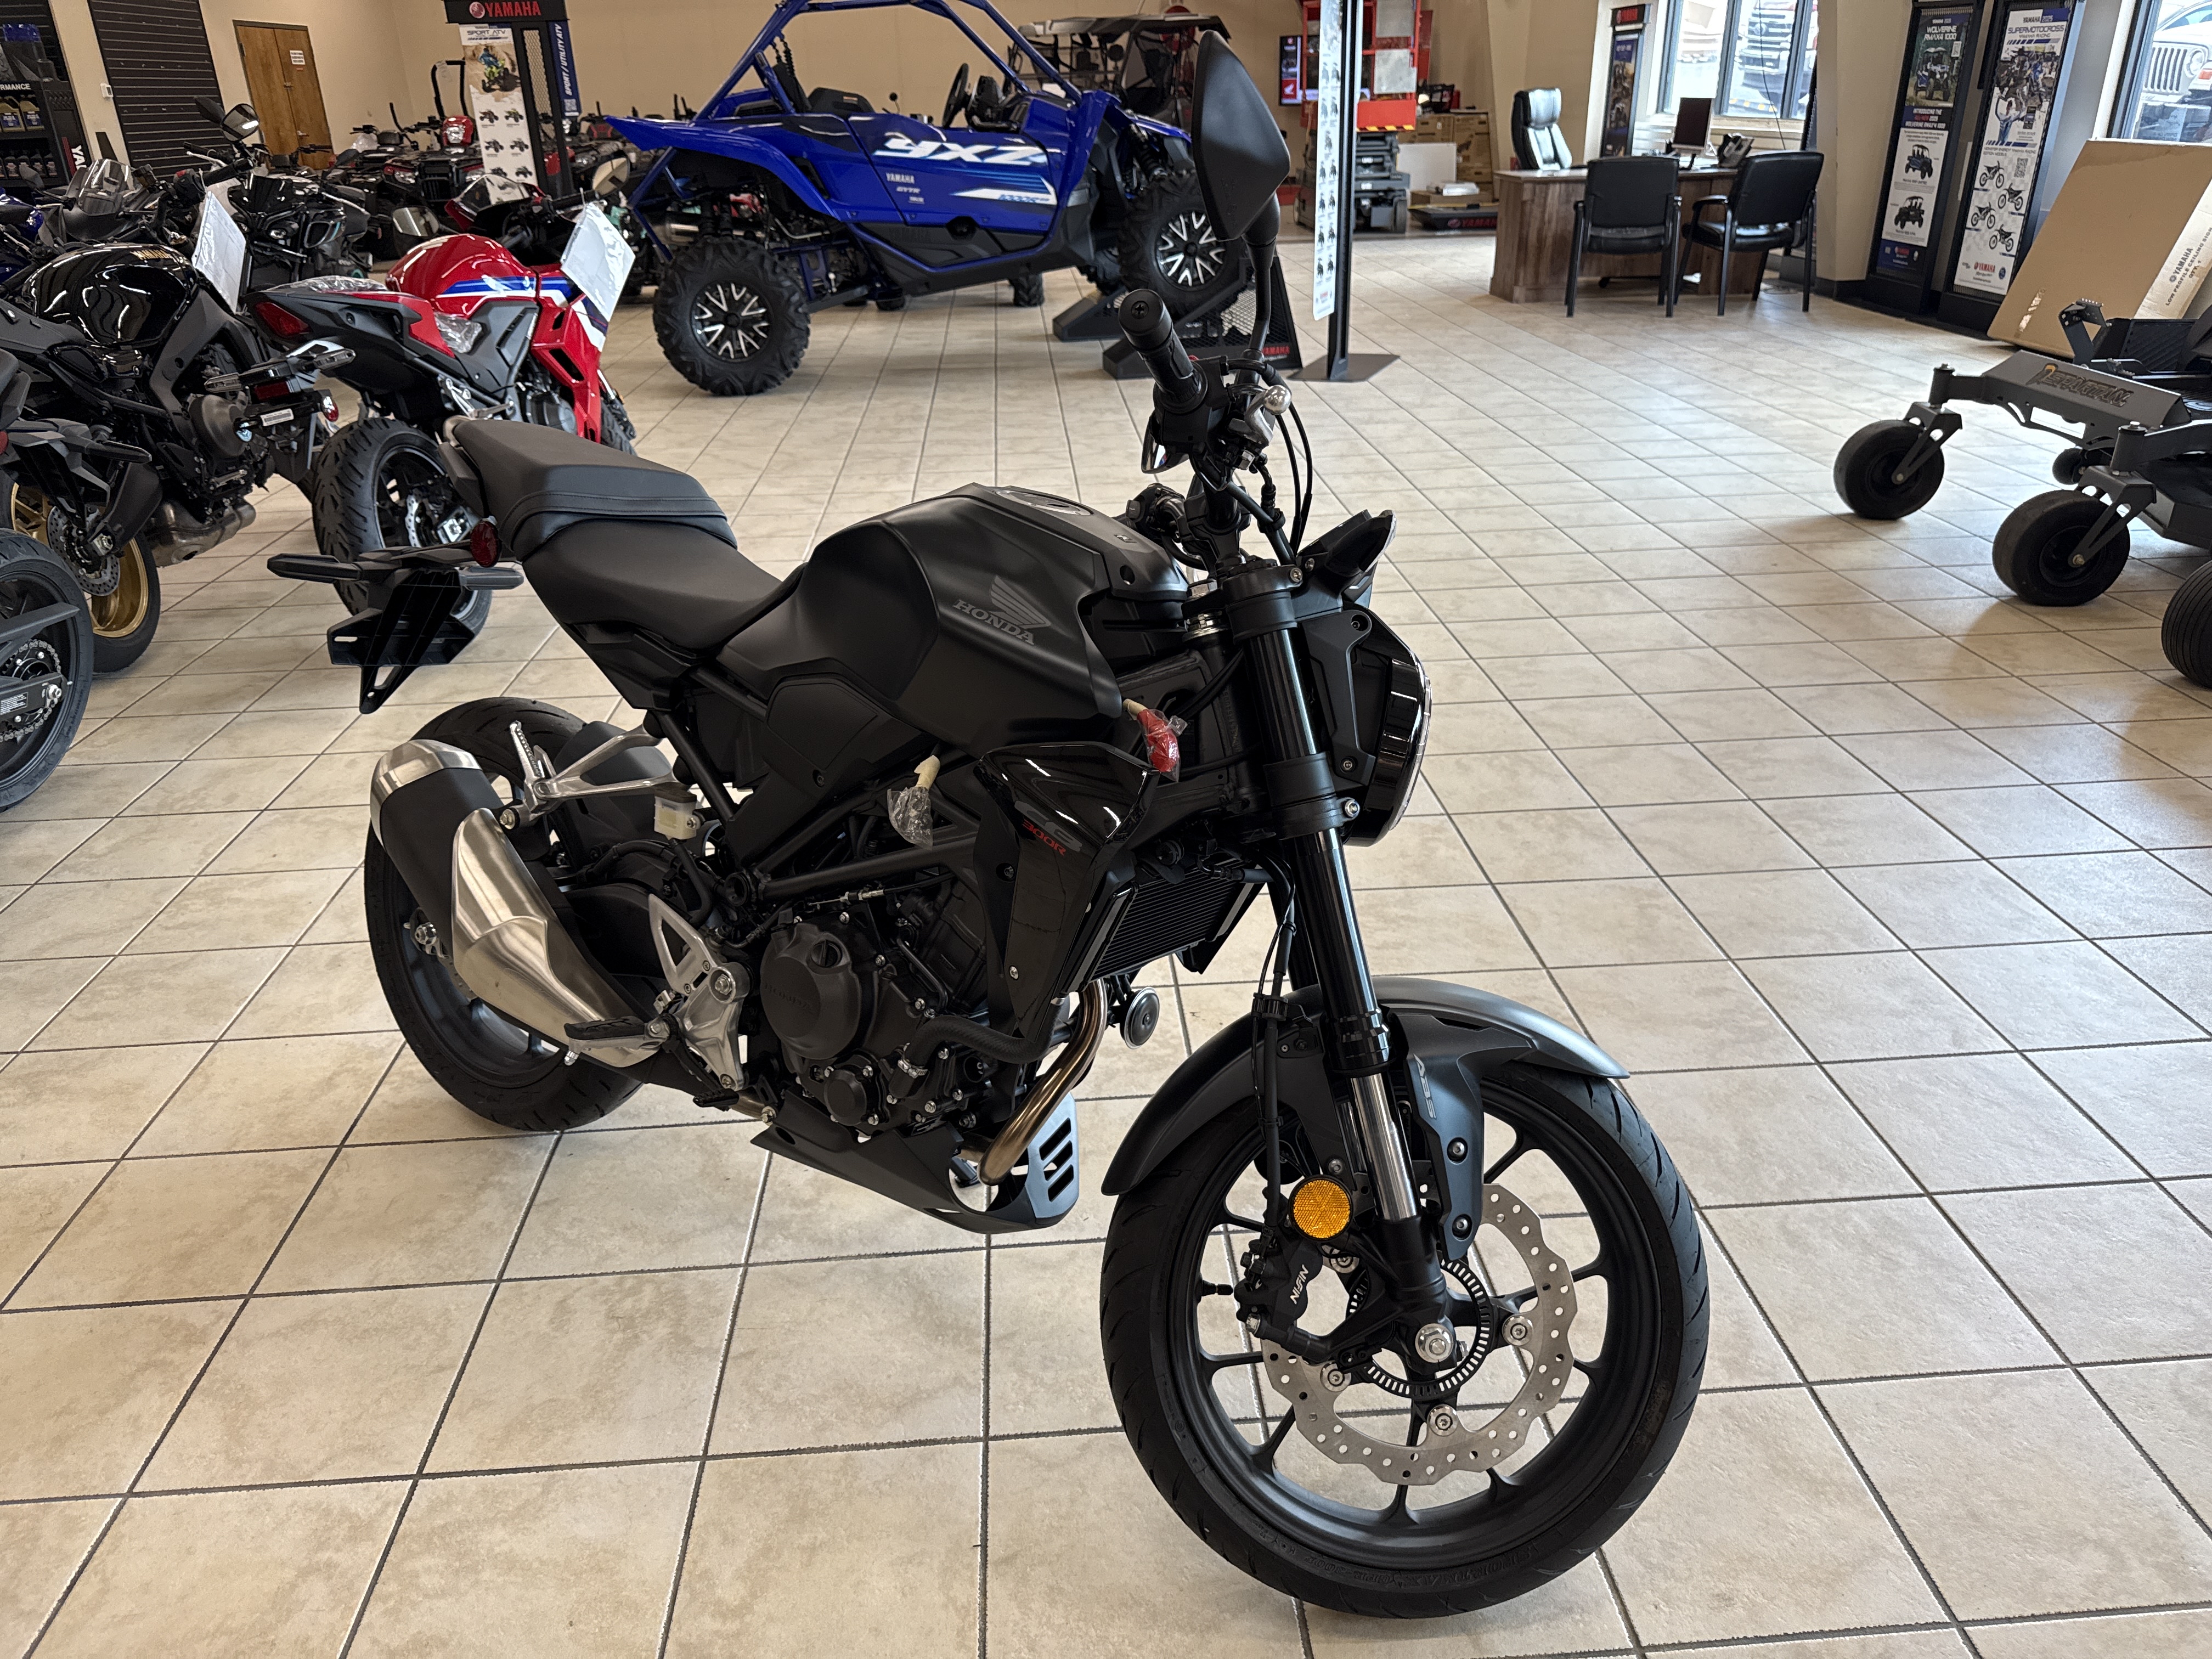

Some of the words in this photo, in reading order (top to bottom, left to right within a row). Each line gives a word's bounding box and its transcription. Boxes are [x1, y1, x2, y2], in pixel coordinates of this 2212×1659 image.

[485, 1, 541, 17] YAMAHA
[554, 23, 565, 39] ATV
[556, 38, 568, 67] UTILITY
[561, 72, 573, 96] SPORT
[886, 173, 915, 184] YAMAHA
[2165, 293, 2175, 306] LOW
[2173, 268, 2190, 292] PROFILE
[2187, 243, 2204, 267] CEILING
[2173, 248, 2193, 275] YAMAHA
[2042, 370, 2134, 407] SPARTAN
[953, 599, 1035, 645] HONDA
[1014, 800, 1083, 852] CB
[1022, 818, 1066, 856] 300R
[1413, 1053, 1437, 1119] ABS
